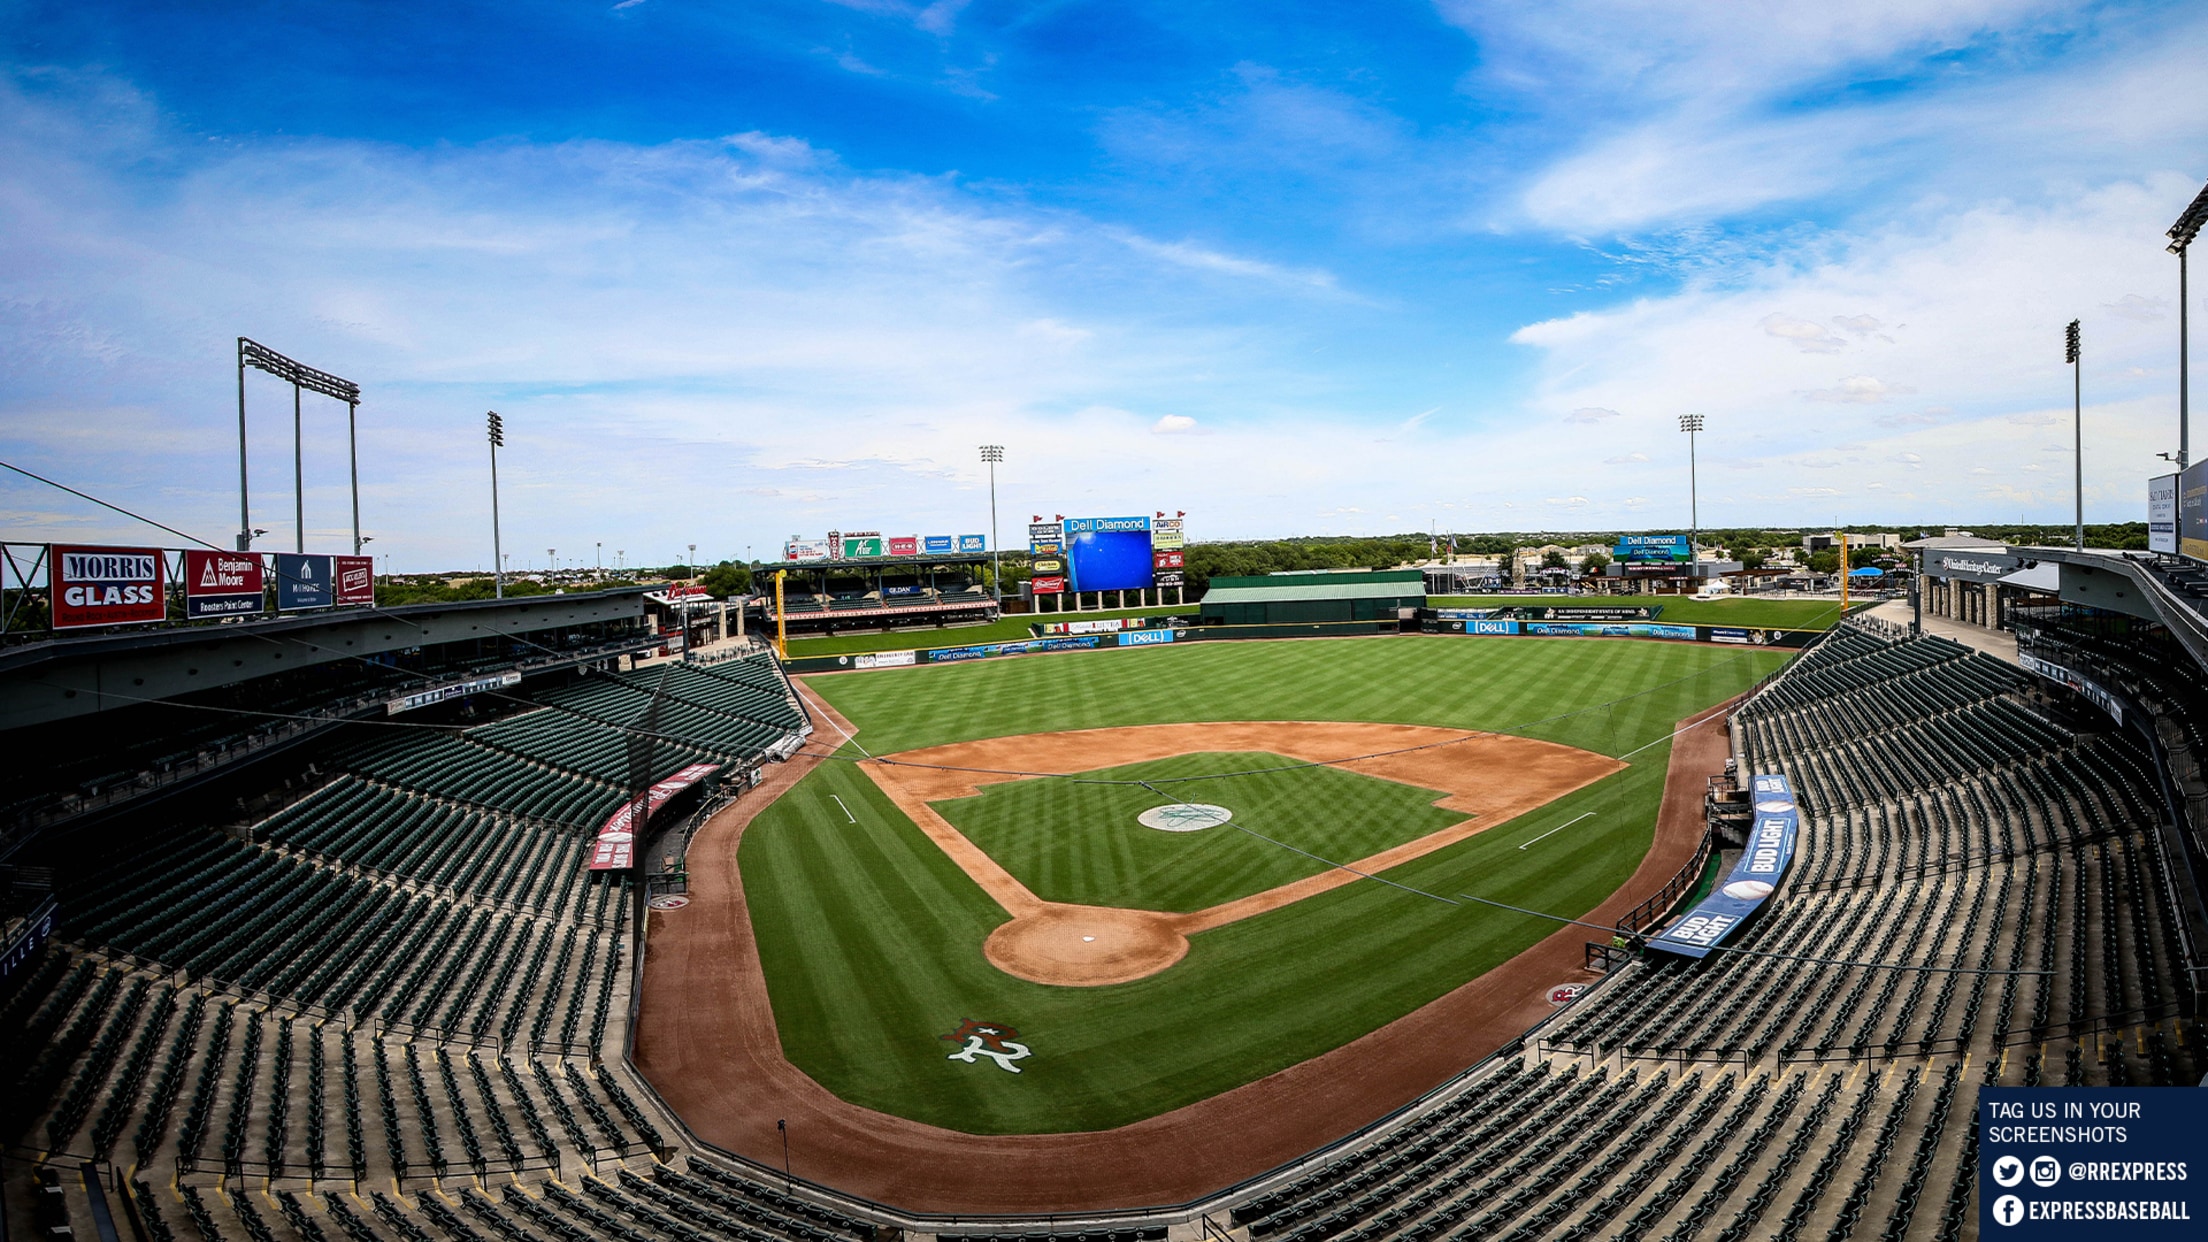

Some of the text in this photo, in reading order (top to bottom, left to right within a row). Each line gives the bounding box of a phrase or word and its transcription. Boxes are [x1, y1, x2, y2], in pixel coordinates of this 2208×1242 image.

[1071, 519, 1093, 531] Dell
[1096, 517, 1144, 530] Diamond
[1627, 536, 1676, 545] Dell Diamond
[68, 556, 153, 578] MORRIS
[218, 558, 253, 574] Benjamin
[219, 573, 244, 586] Moore
[65, 585, 154, 606] GLASS
[1480, 622, 1505, 632] DELL
[1133, 631, 1161, 643] DELL
[1751, 819, 1785, 873] BUD LIGHT
[1671, 916, 1710, 939] BUD
[1686, 915, 1735, 946] LIGHT
